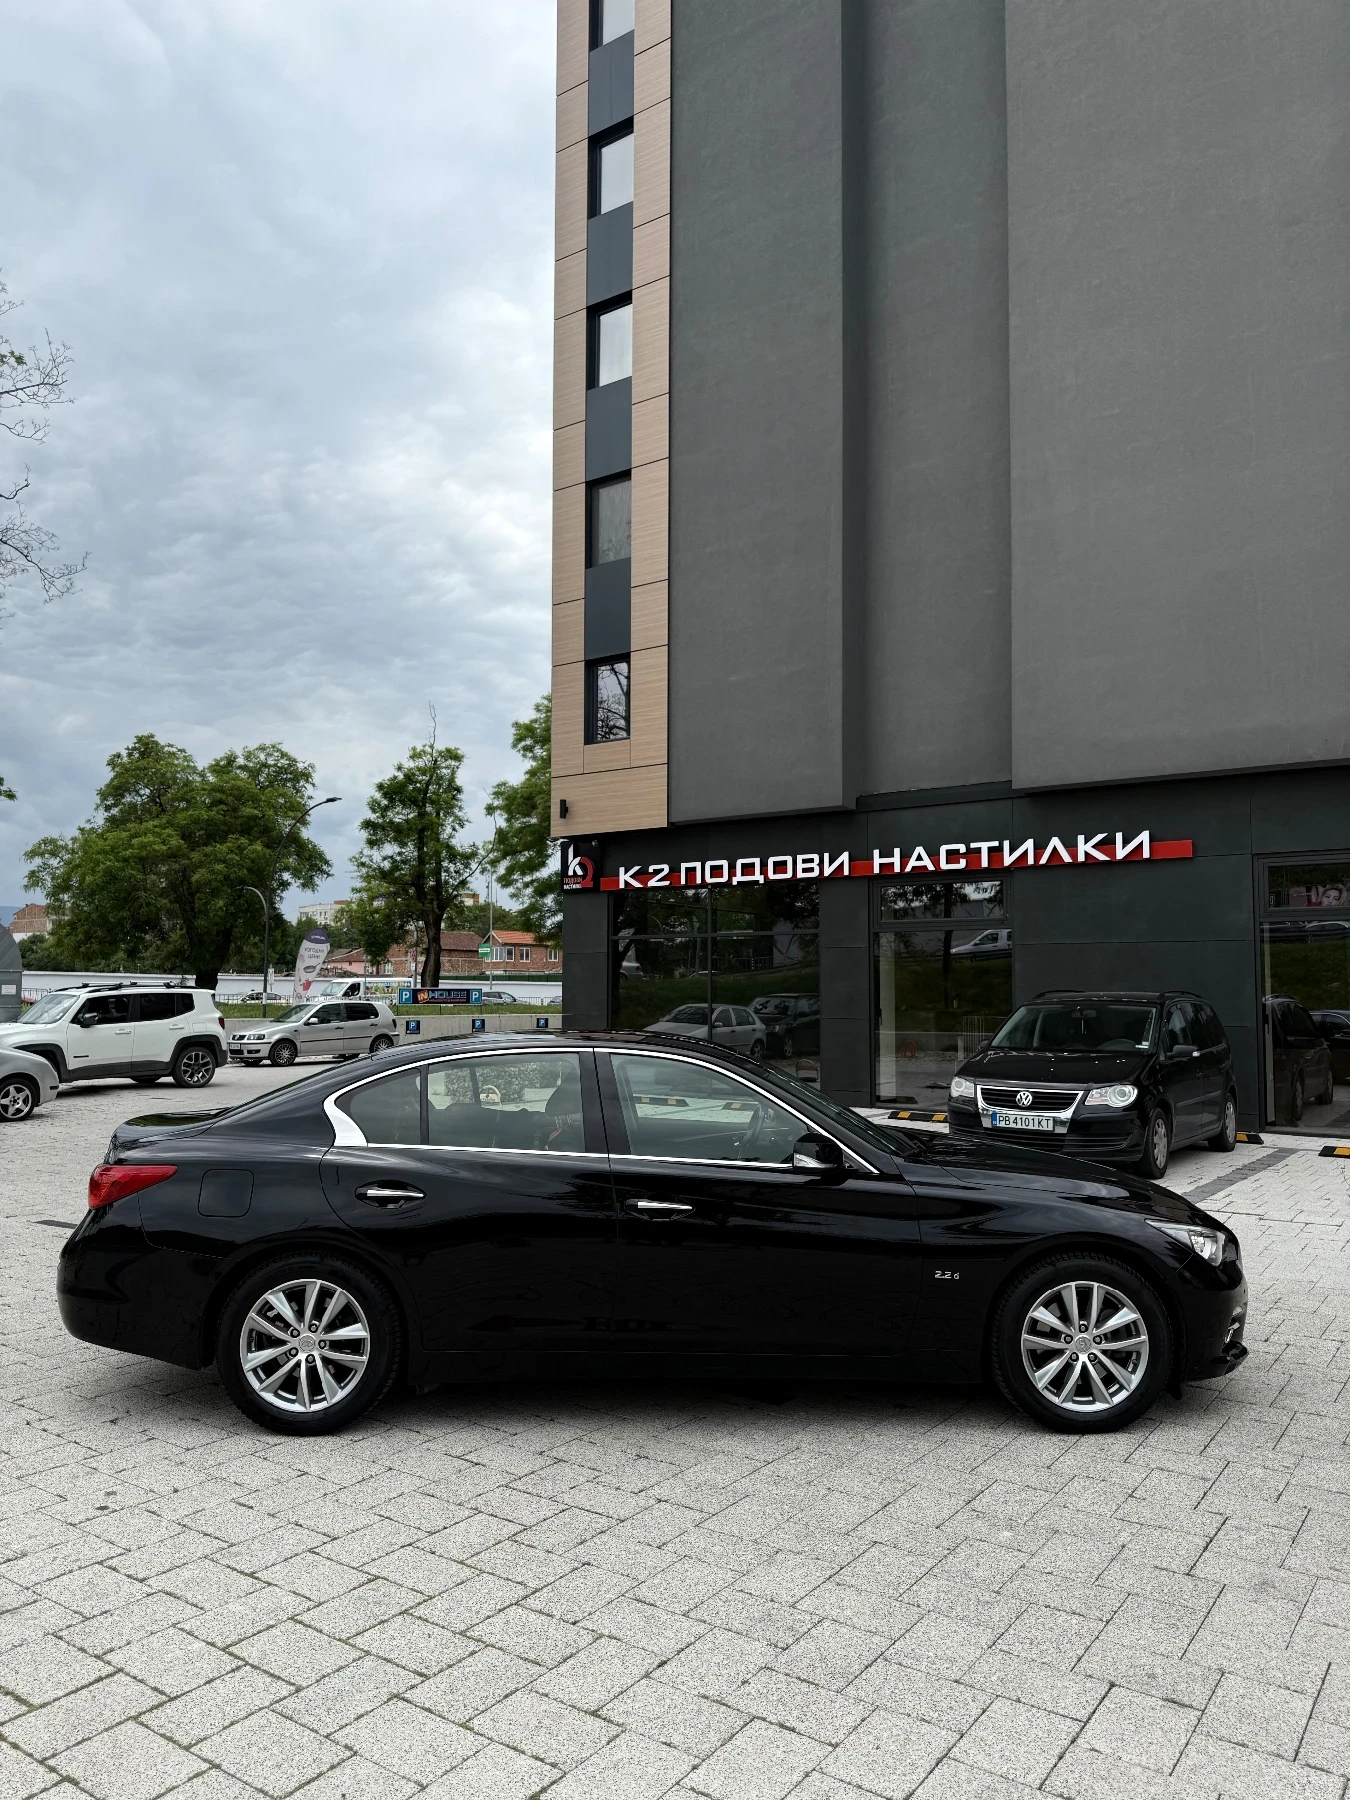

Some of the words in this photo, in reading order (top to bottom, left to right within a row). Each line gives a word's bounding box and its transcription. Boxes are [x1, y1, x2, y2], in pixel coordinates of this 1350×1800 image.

[618, 863, 672, 889] К2
[680, 851, 850, 886] ПОДОВИ
[873, 830, 1150, 874] НАСТИЛКИ
[402, 992, 410, 1002] P
[472, 992, 479, 1002] P
[998, 1115, 1010, 1126] PB
[1012, 1116, 1035, 1127] 4101
[1038, 1118, 1051, 1128] KT
